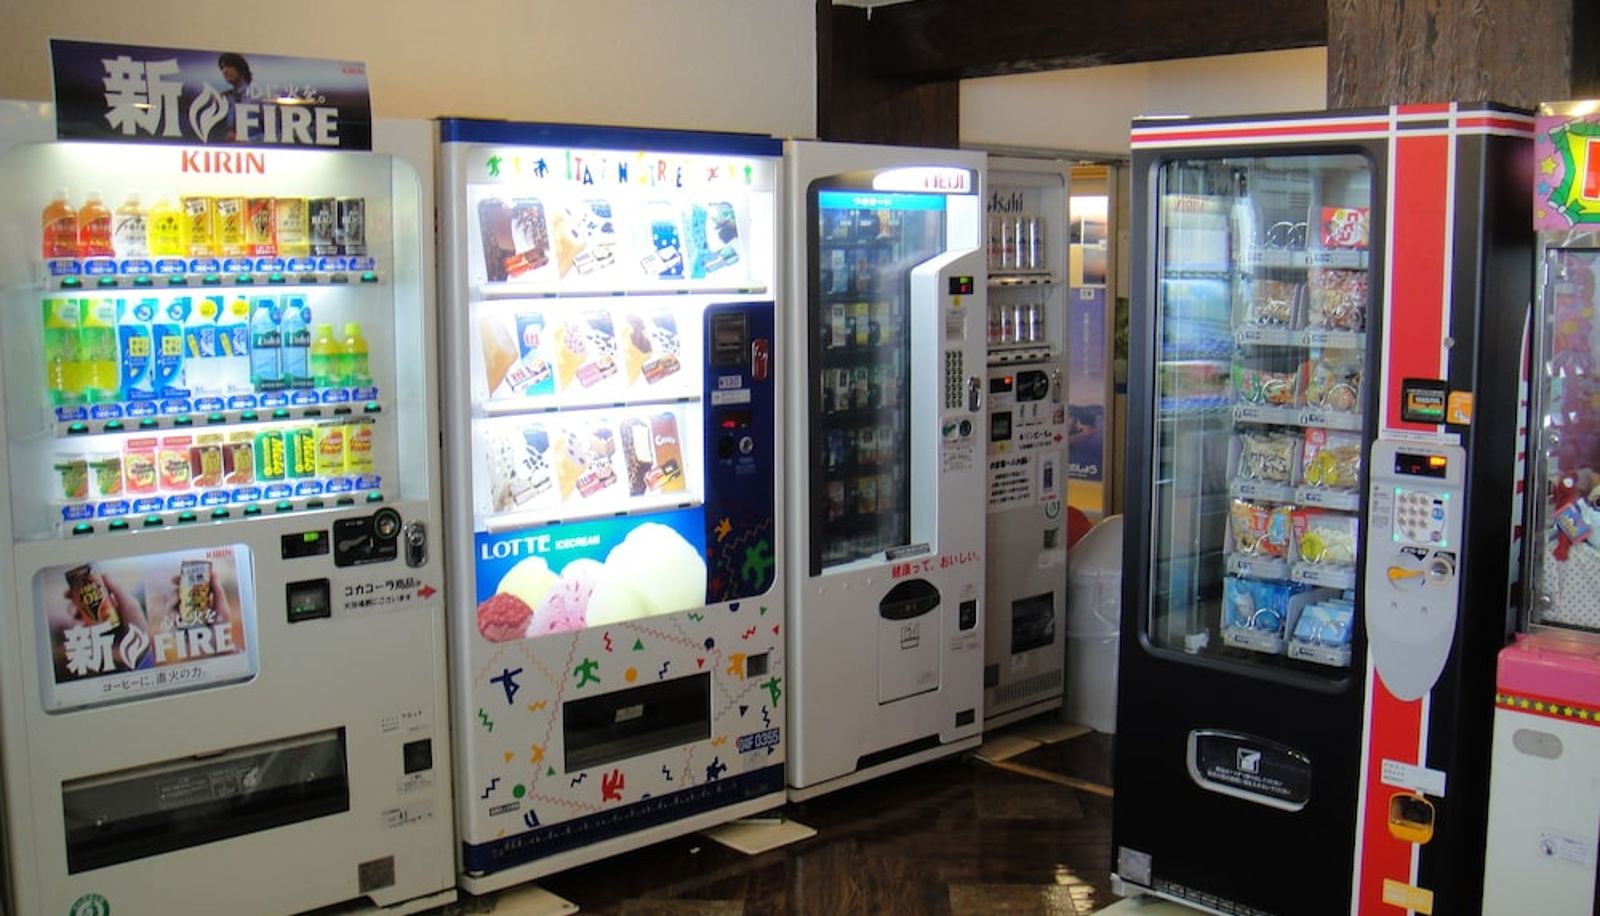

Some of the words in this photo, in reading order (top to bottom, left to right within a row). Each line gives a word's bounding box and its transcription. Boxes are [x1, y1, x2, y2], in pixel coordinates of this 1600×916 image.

[102, 55, 184, 138] 新
[235, 103, 340, 146] FIRE
[181, 150, 265, 175] KIRIN
[481, 533, 551, 560] LOTTE
[63, 621, 117, 676] 新
[153, 623, 237, 663] FIRE
